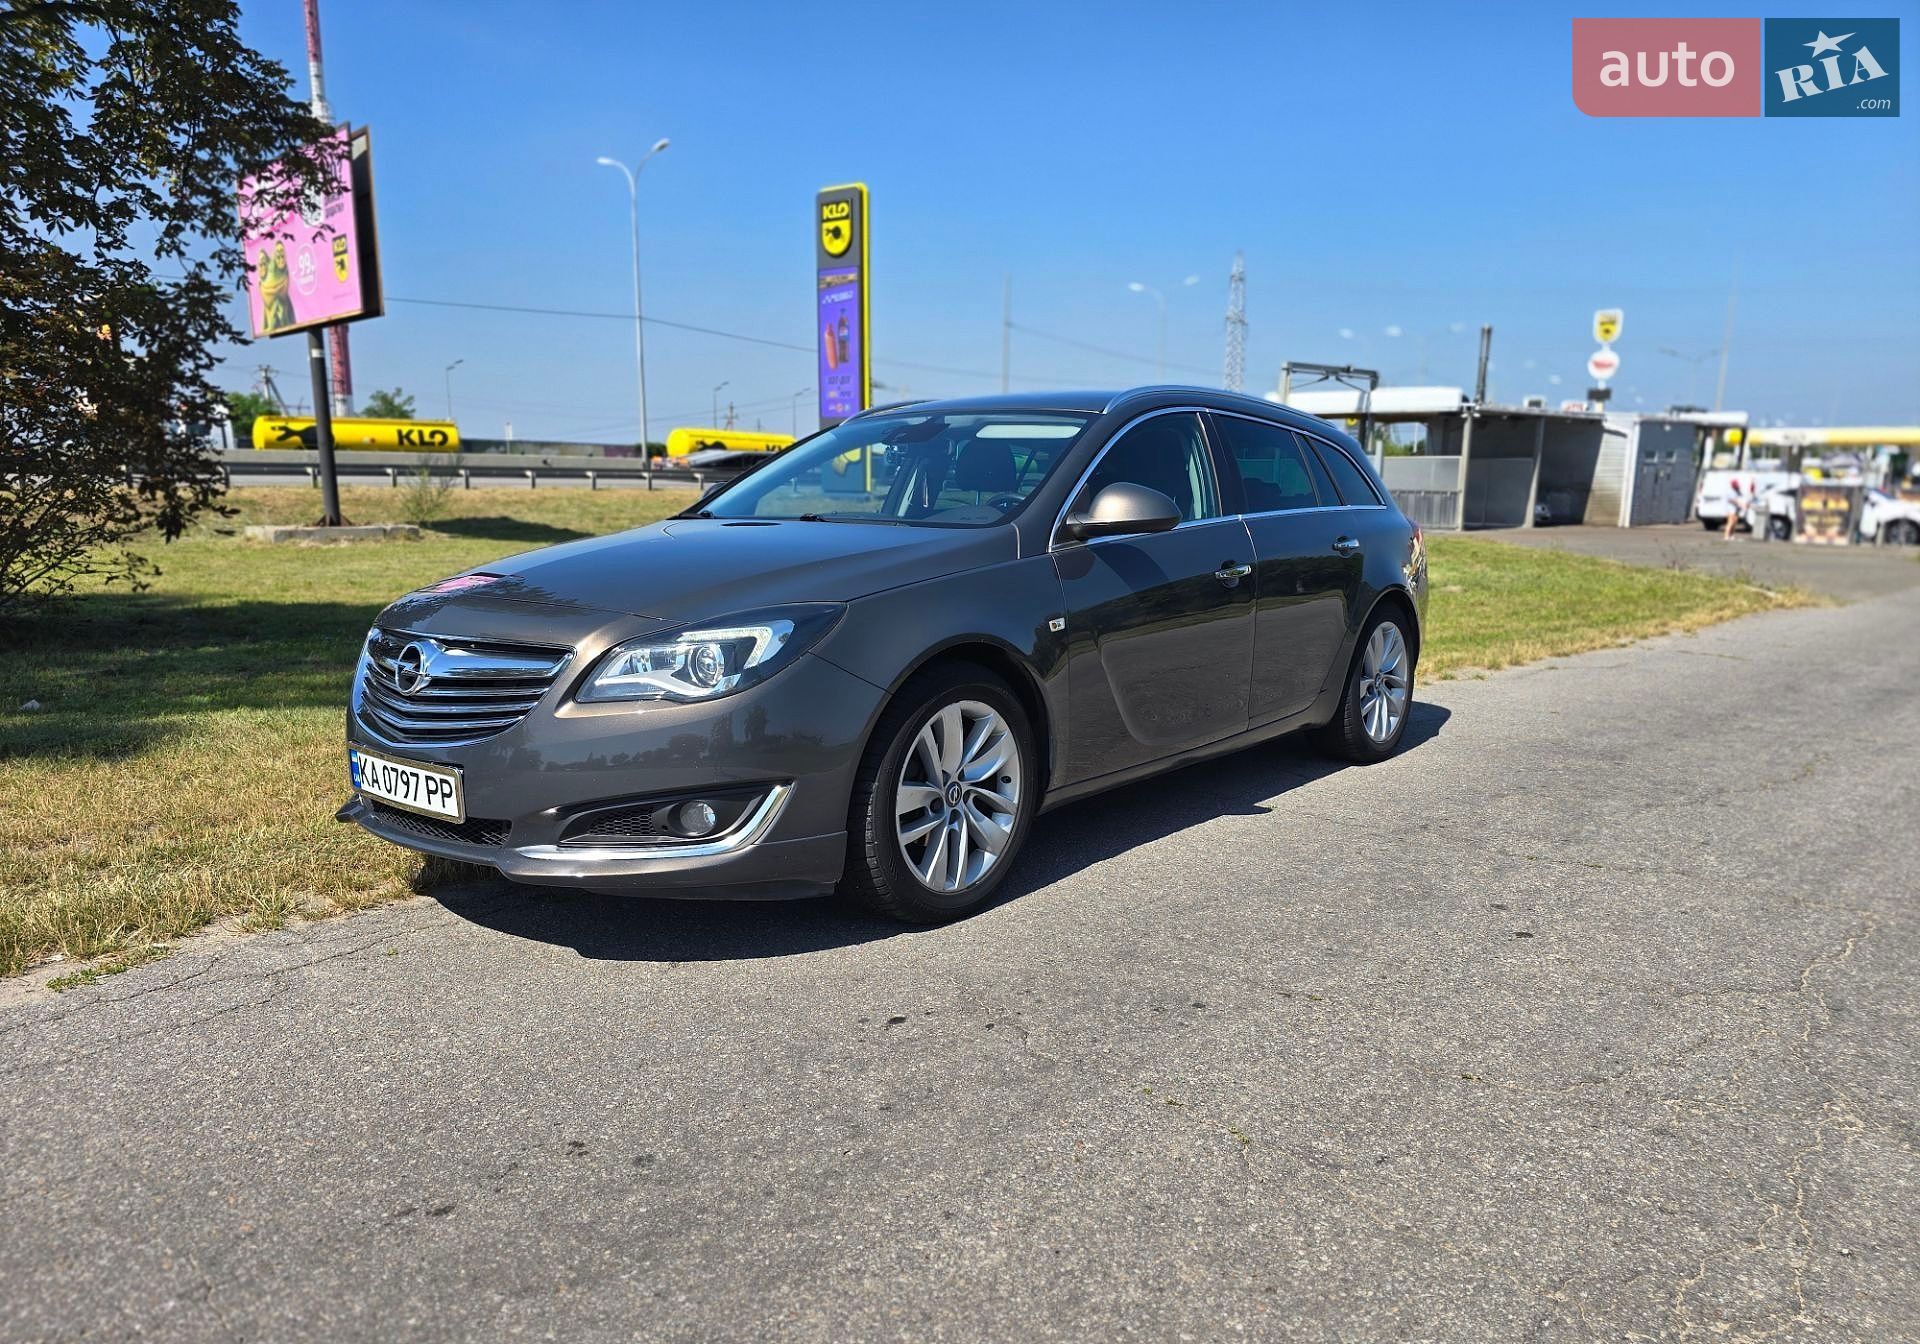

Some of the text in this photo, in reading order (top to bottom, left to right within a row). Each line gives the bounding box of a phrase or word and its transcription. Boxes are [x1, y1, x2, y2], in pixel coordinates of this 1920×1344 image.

[397, 429, 449, 446] KLO
[358, 756, 453, 808] KA 0797 PP
